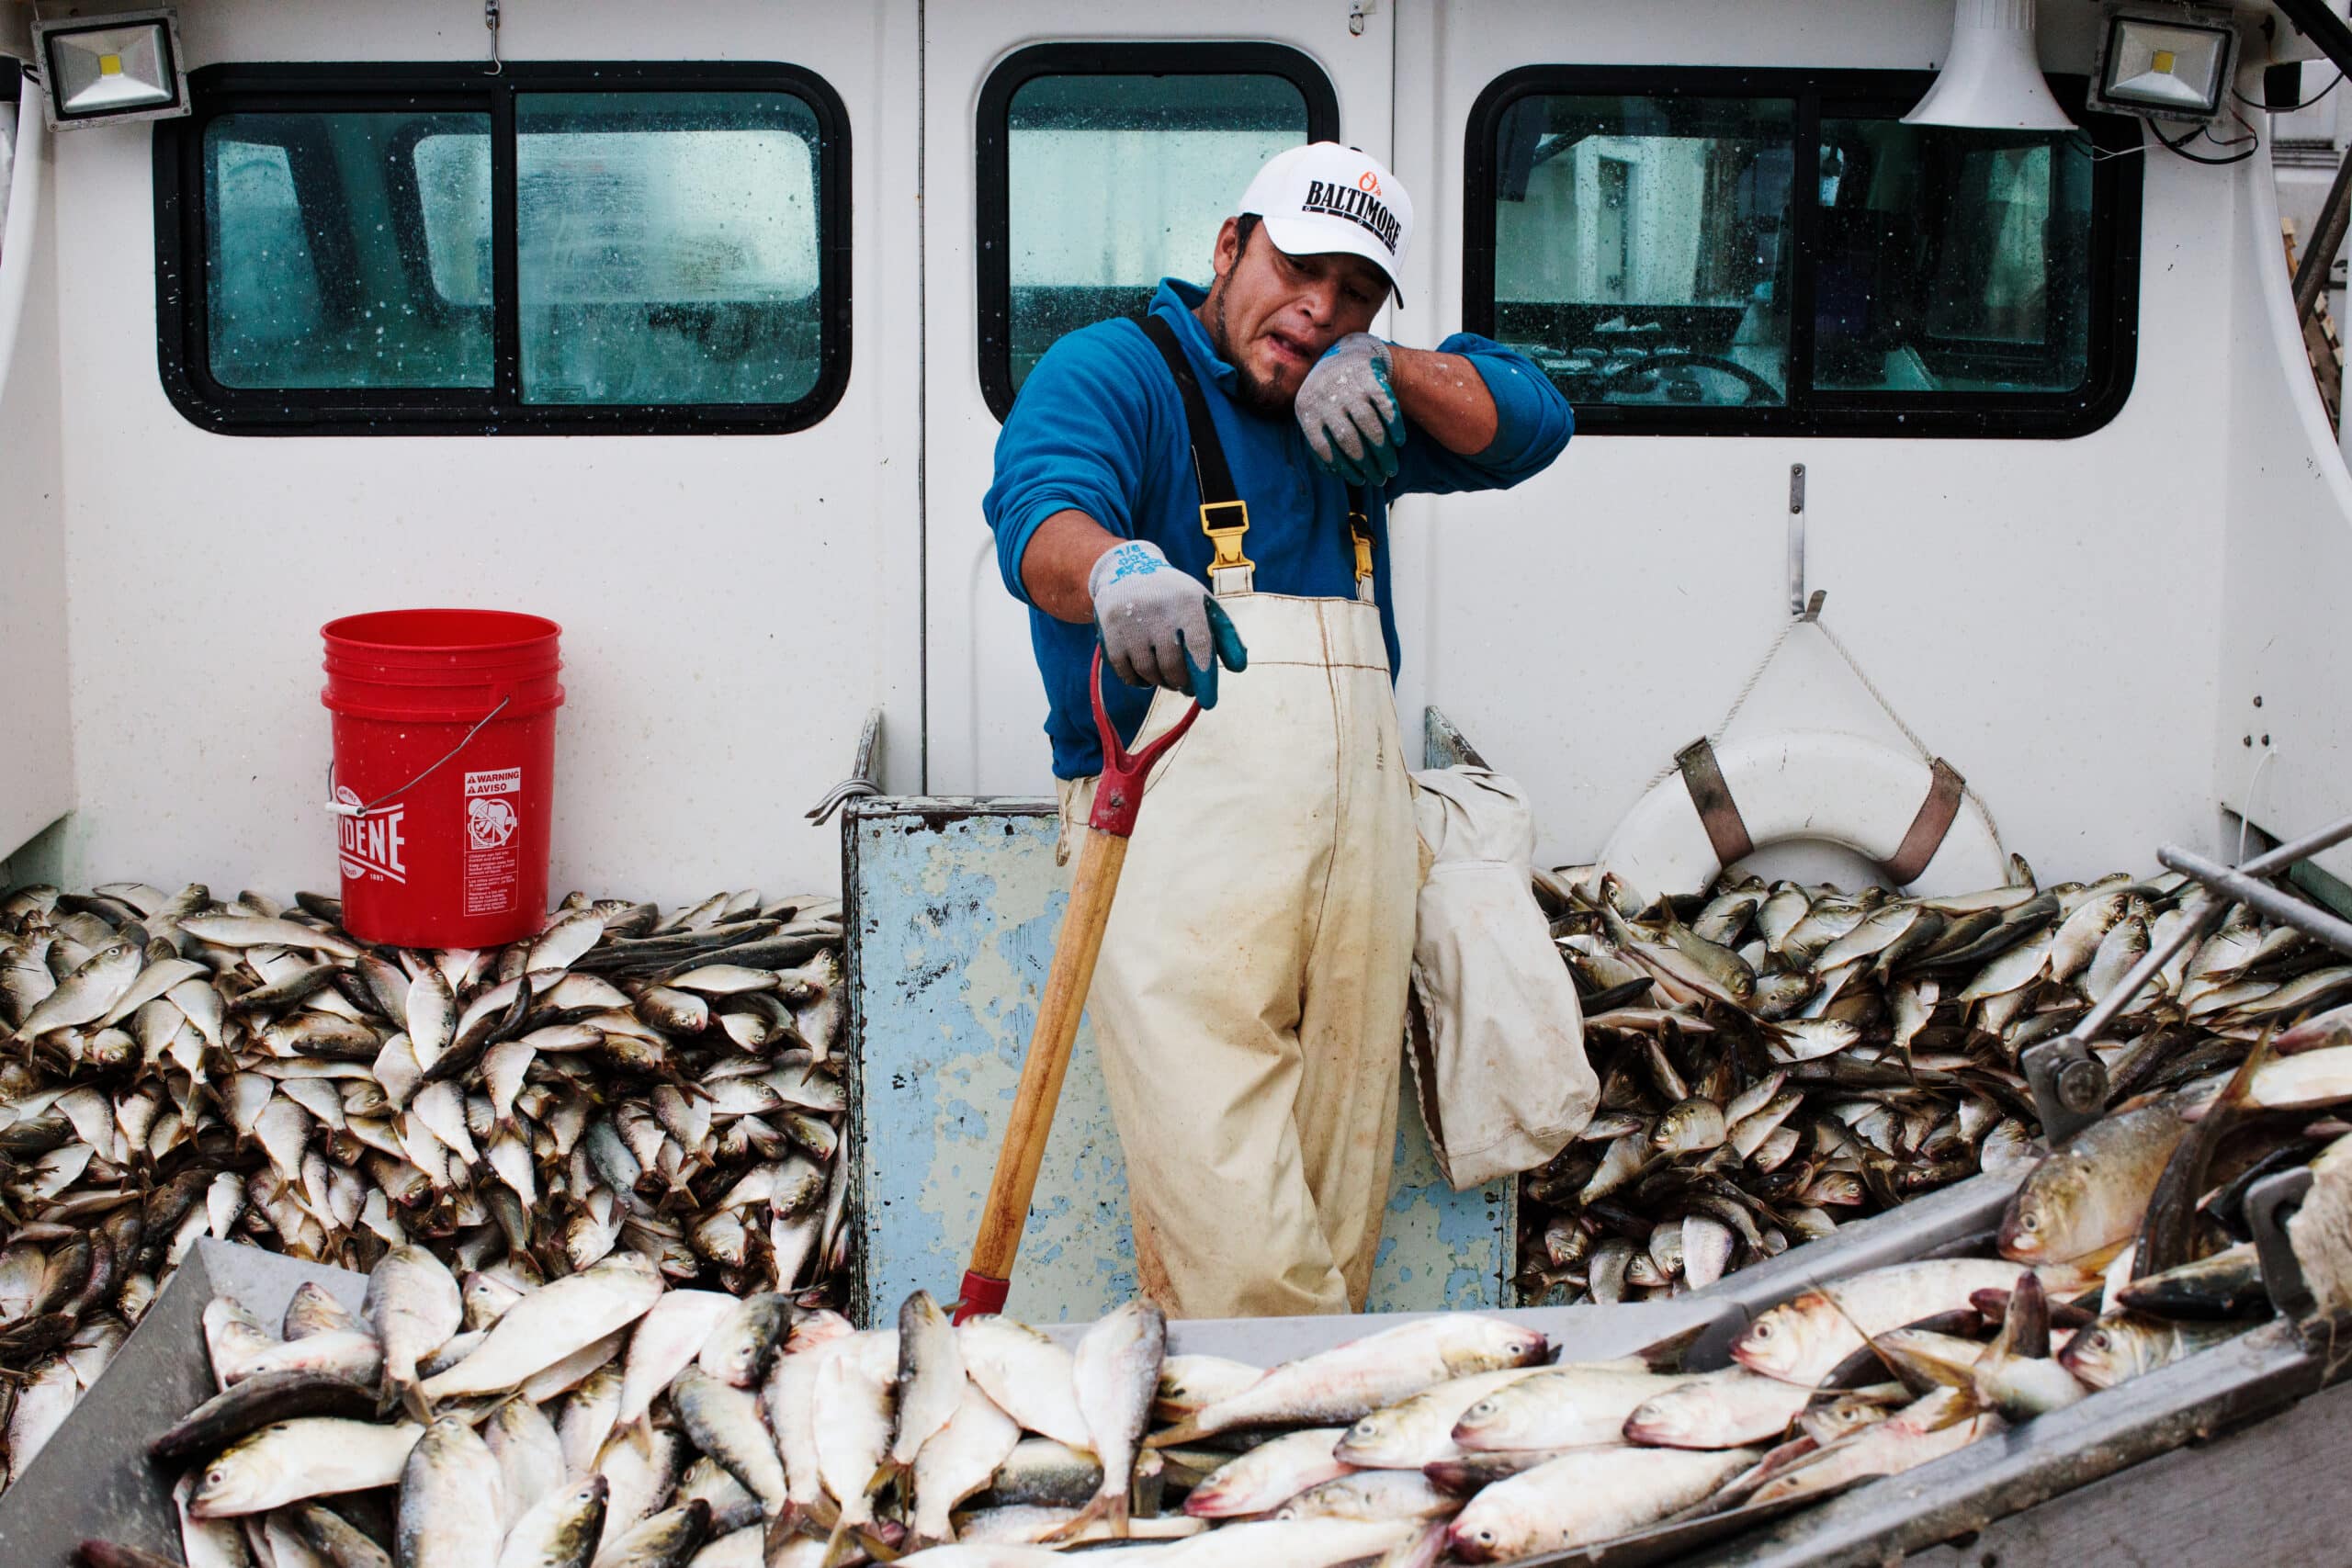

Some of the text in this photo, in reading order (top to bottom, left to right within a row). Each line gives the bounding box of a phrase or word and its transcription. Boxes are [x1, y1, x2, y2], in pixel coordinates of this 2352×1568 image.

[1306, 180, 1401, 248] BALTIMORE
[477, 771, 520, 784] WARNING
[477, 783, 507, 794] AVISO
